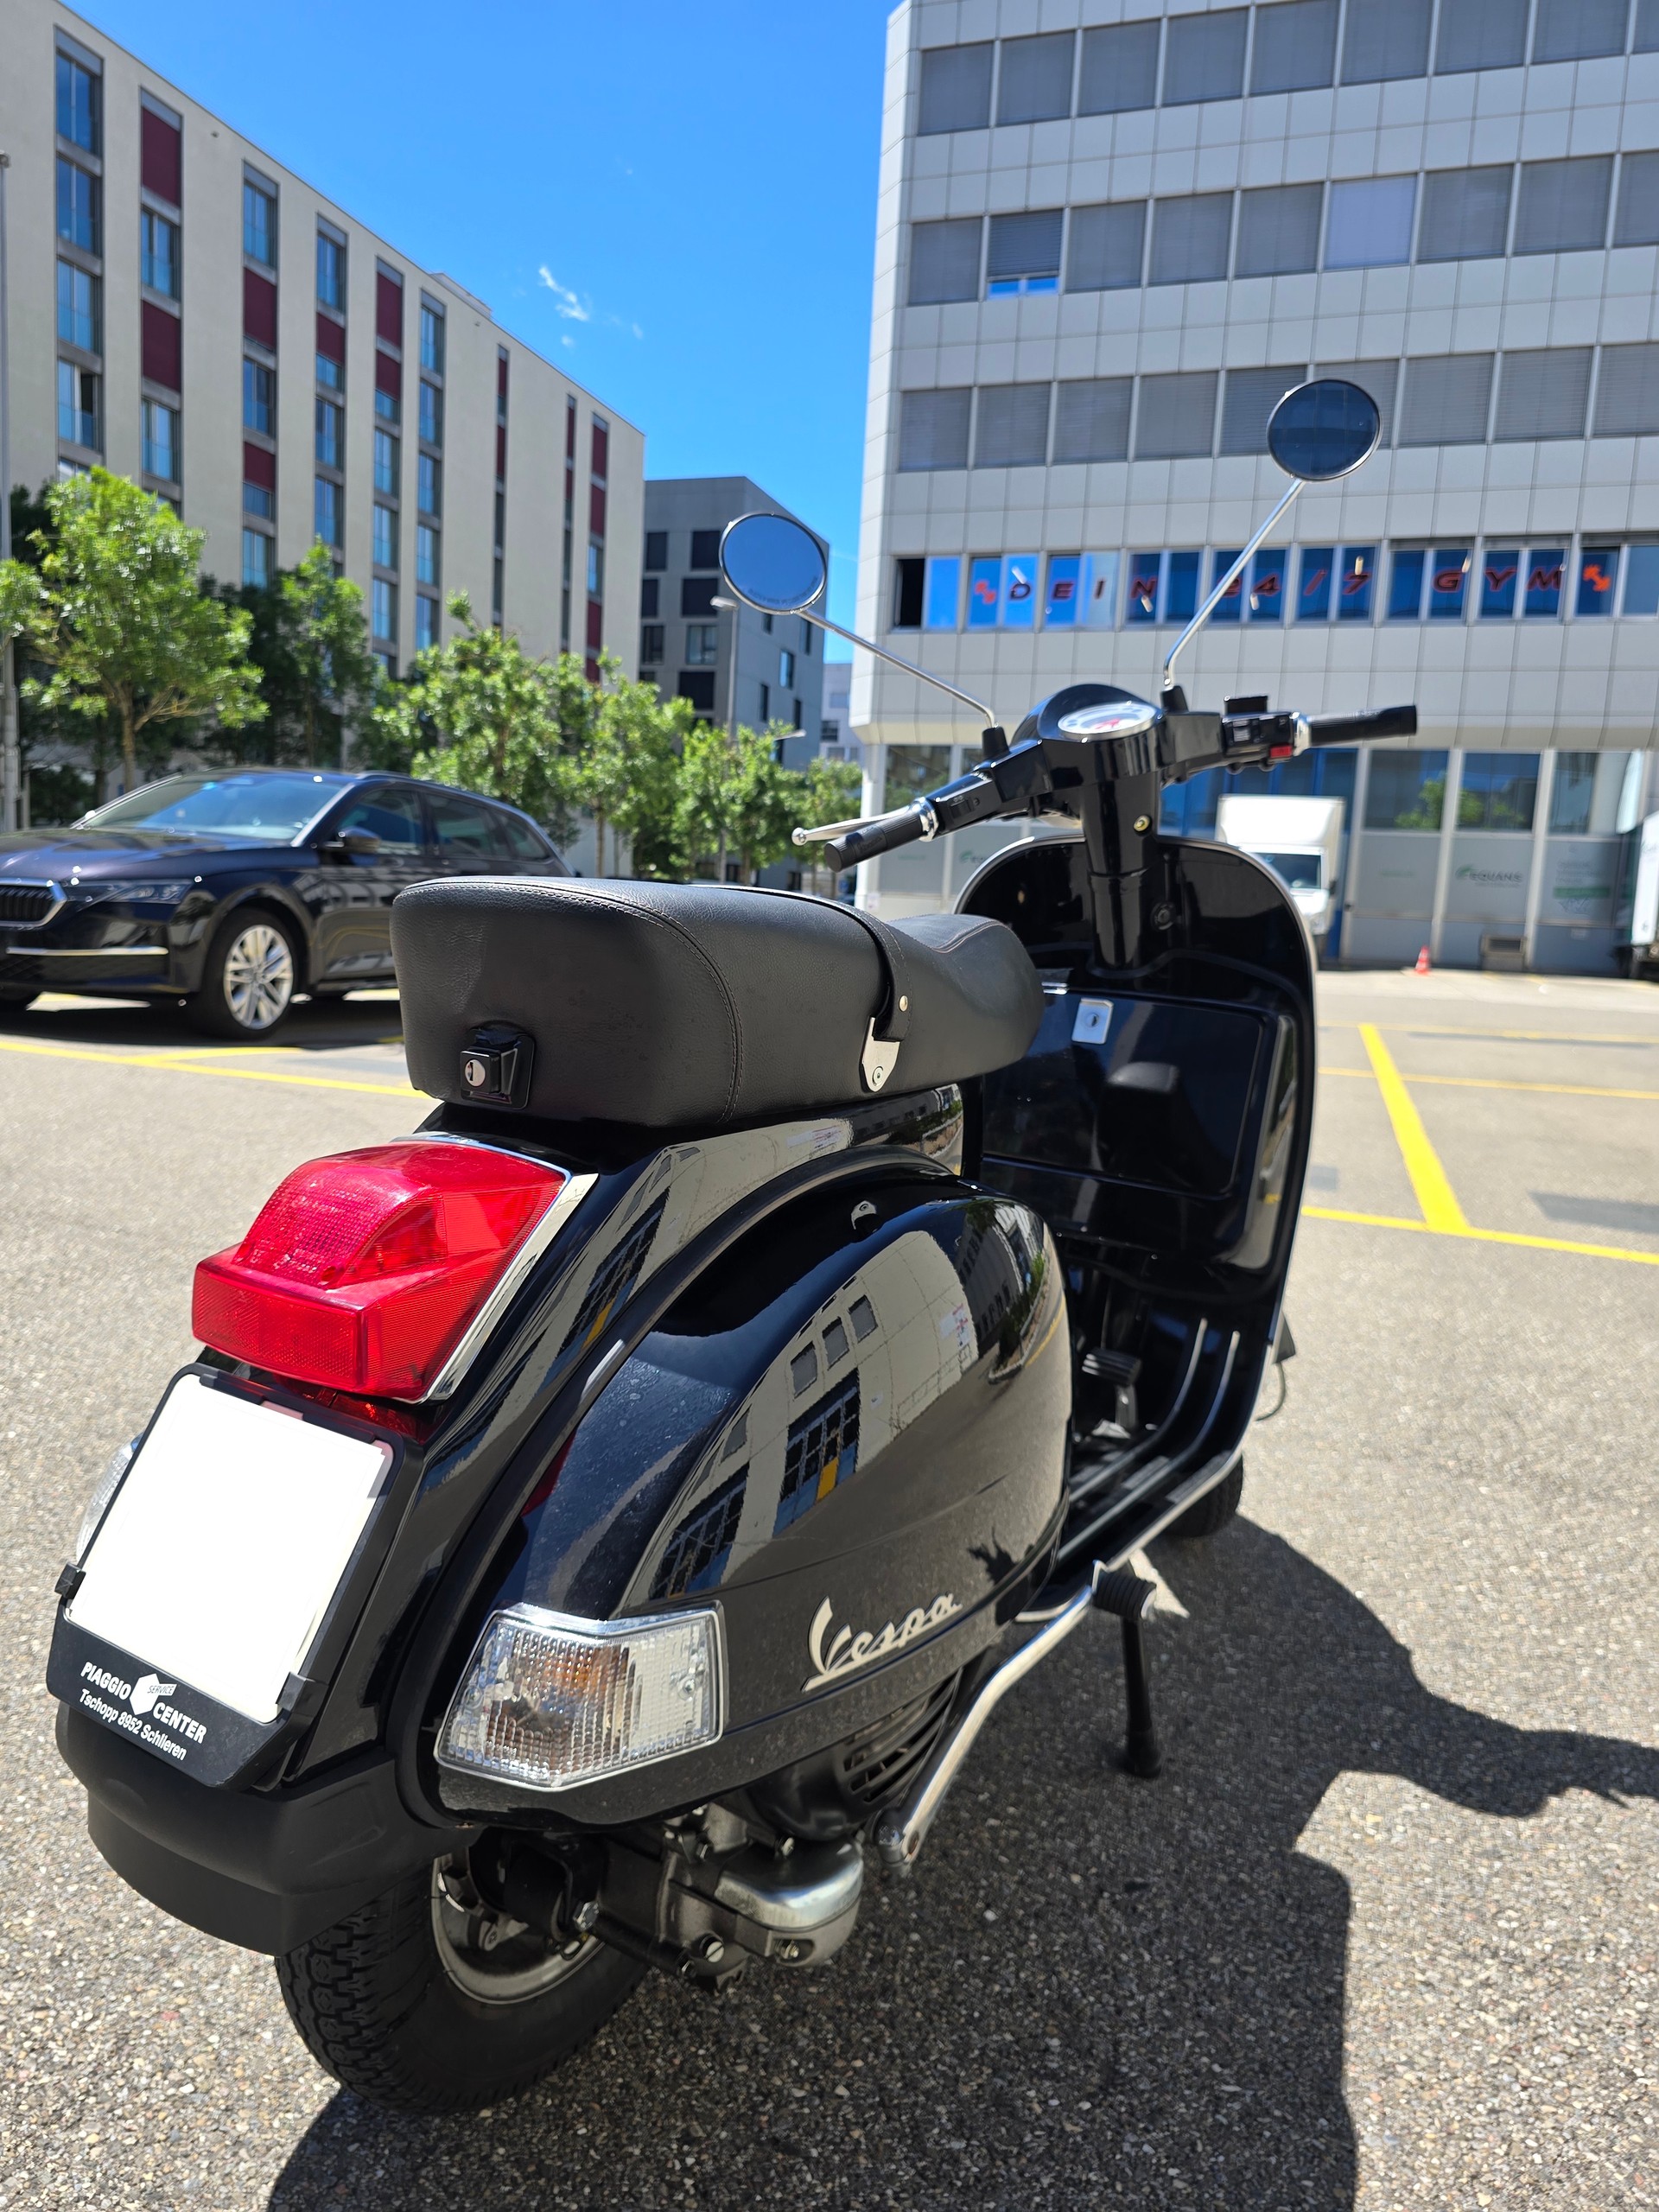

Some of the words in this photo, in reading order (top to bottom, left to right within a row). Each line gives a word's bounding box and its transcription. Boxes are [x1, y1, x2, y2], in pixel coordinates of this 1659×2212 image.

[1009, 576, 1158, 601] DEIN
[1432, 566, 1563, 594] GYM
[800, 1591, 963, 1694] Vespa
[79, 1688, 118, 1724] Tschopp
[118, 1711, 143, 1735] 8952
[140, 1724, 187, 1761] Schlieren
[80, 1661, 131, 1700] PIAGGIO
[152, 1701, 207, 1744] CENTER
[147, 1684, 175, 1695] SERVICE
